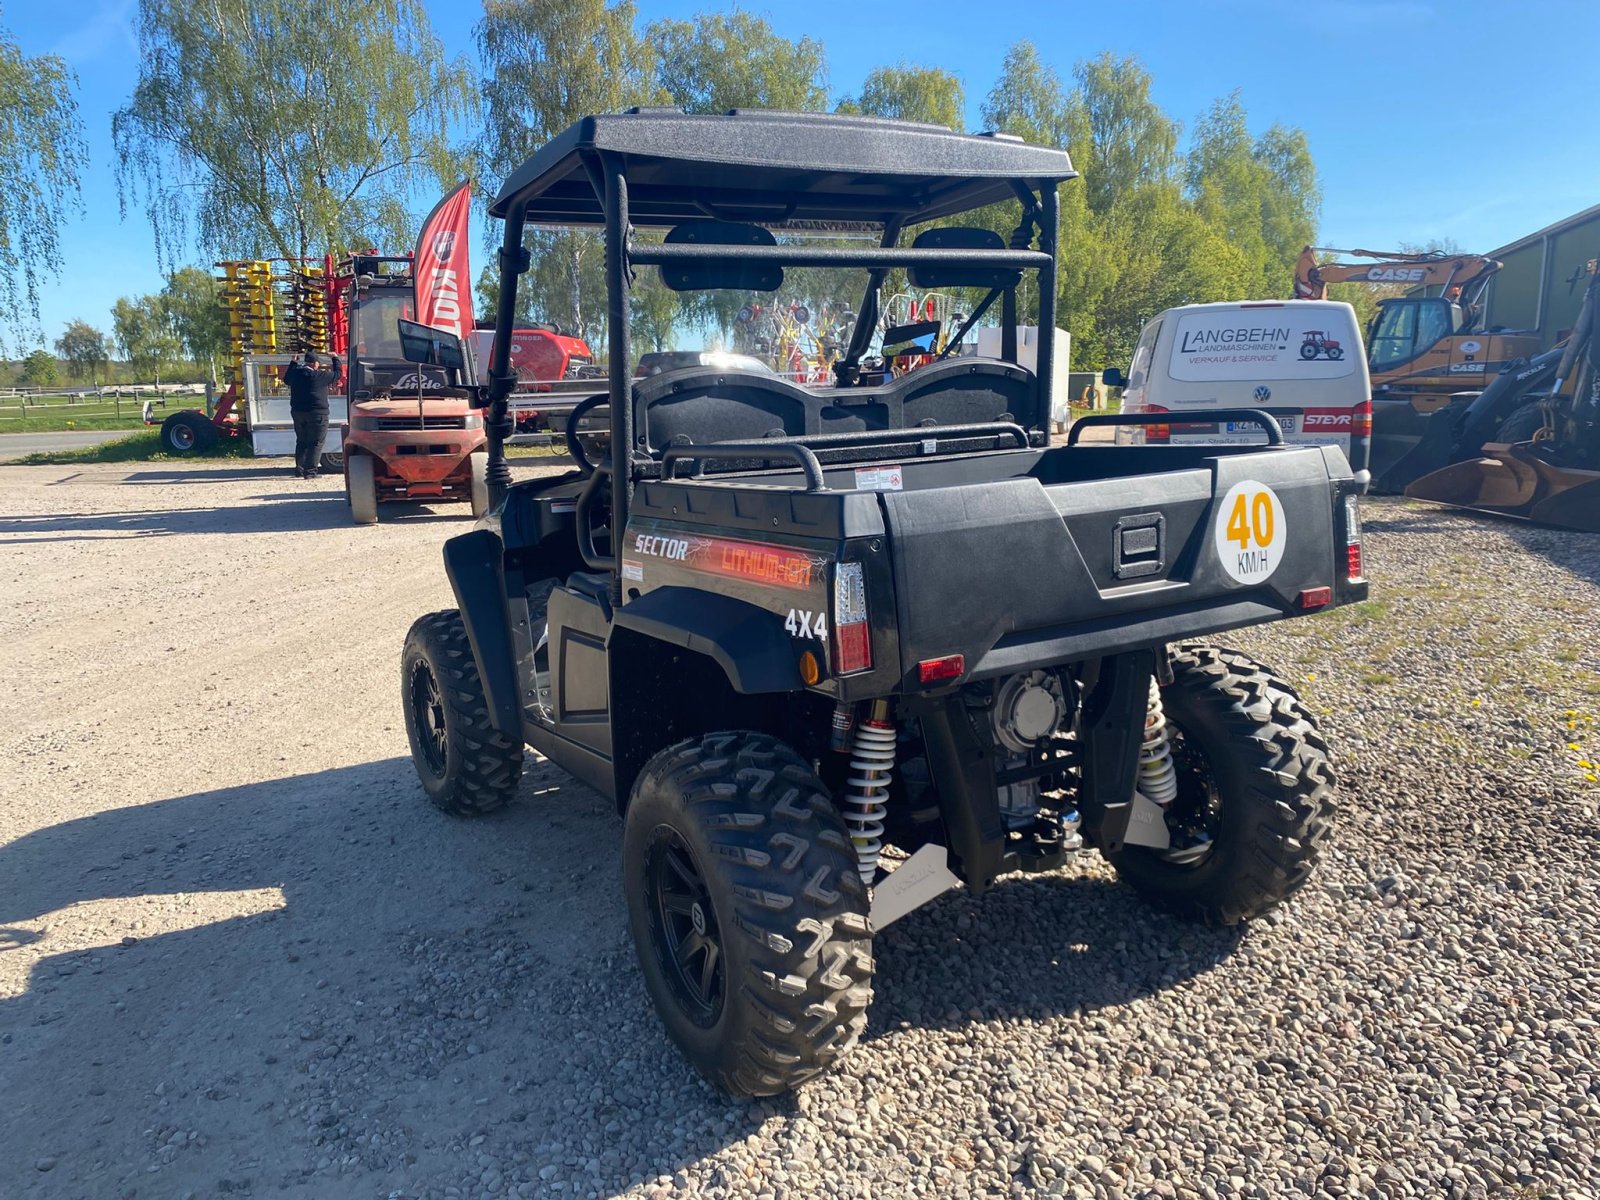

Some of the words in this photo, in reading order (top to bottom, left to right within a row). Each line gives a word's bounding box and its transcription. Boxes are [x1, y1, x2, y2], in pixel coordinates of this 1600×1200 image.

[1367, 267, 1425, 281] CASE
[1181, 328, 1290, 353] LANGBEHN
[1189, 355, 1230, 364] VERKAUF
[1238, 354, 1278, 363] SERVICE
[1449, 364, 1486, 372] CASE
[391, 373, 445, 390] Linde
[1304, 414, 1352, 425] STEYR
[1226, 492, 1274, 549] 40
[634, 534, 688, 561] SECTOR
[721, 546, 812, 585] LITHIUM-ION
[1238, 552, 1269, 575] KM/H
[784, 608, 828, 641] 4X4
